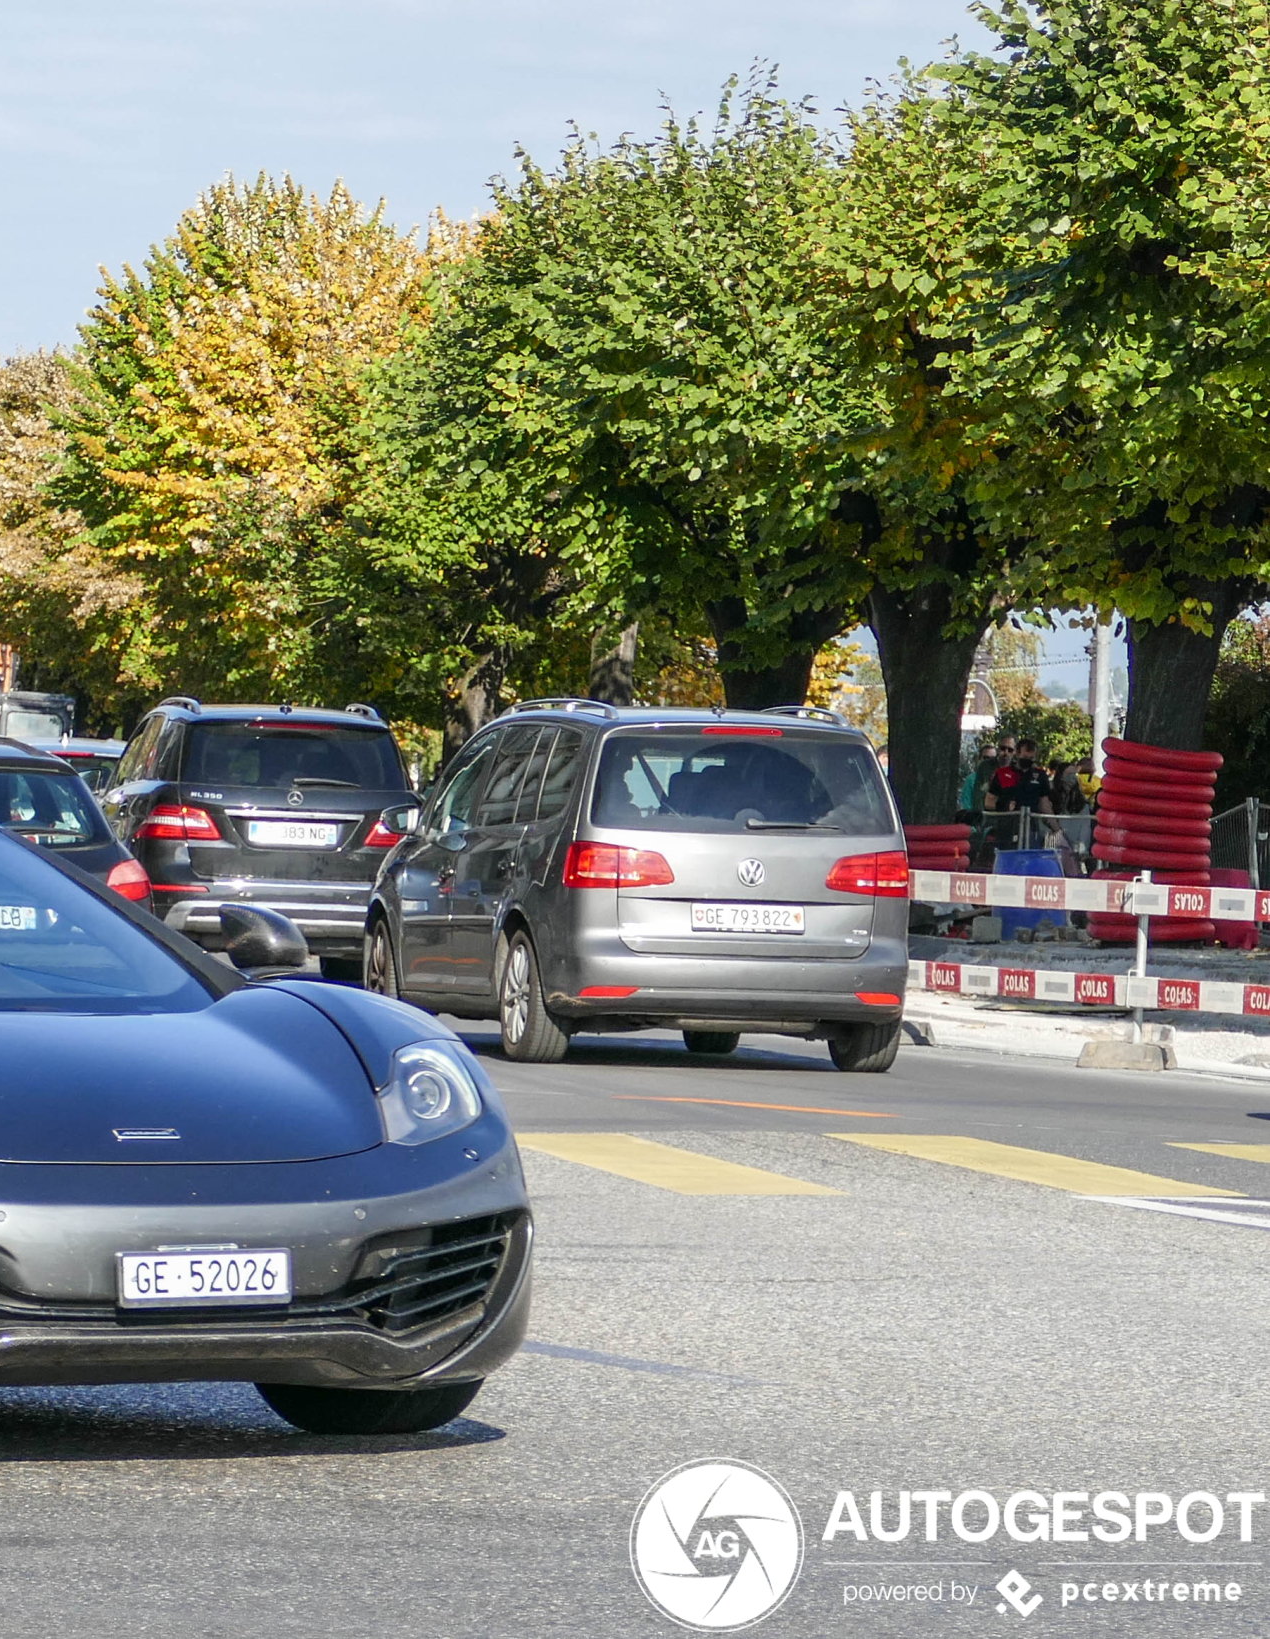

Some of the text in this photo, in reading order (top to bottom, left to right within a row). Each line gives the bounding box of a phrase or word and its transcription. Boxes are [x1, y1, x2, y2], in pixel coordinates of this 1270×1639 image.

[956, 881, 1059, 901] COLAS COLAS
[1174, 893, 1204, 912] COLAS
[705, 908, 791, 927] GE 793822
[931, 969, 1108, 998] COLAS COLAS COLAS
[1164, 986, 1193, 1004] COLAS
